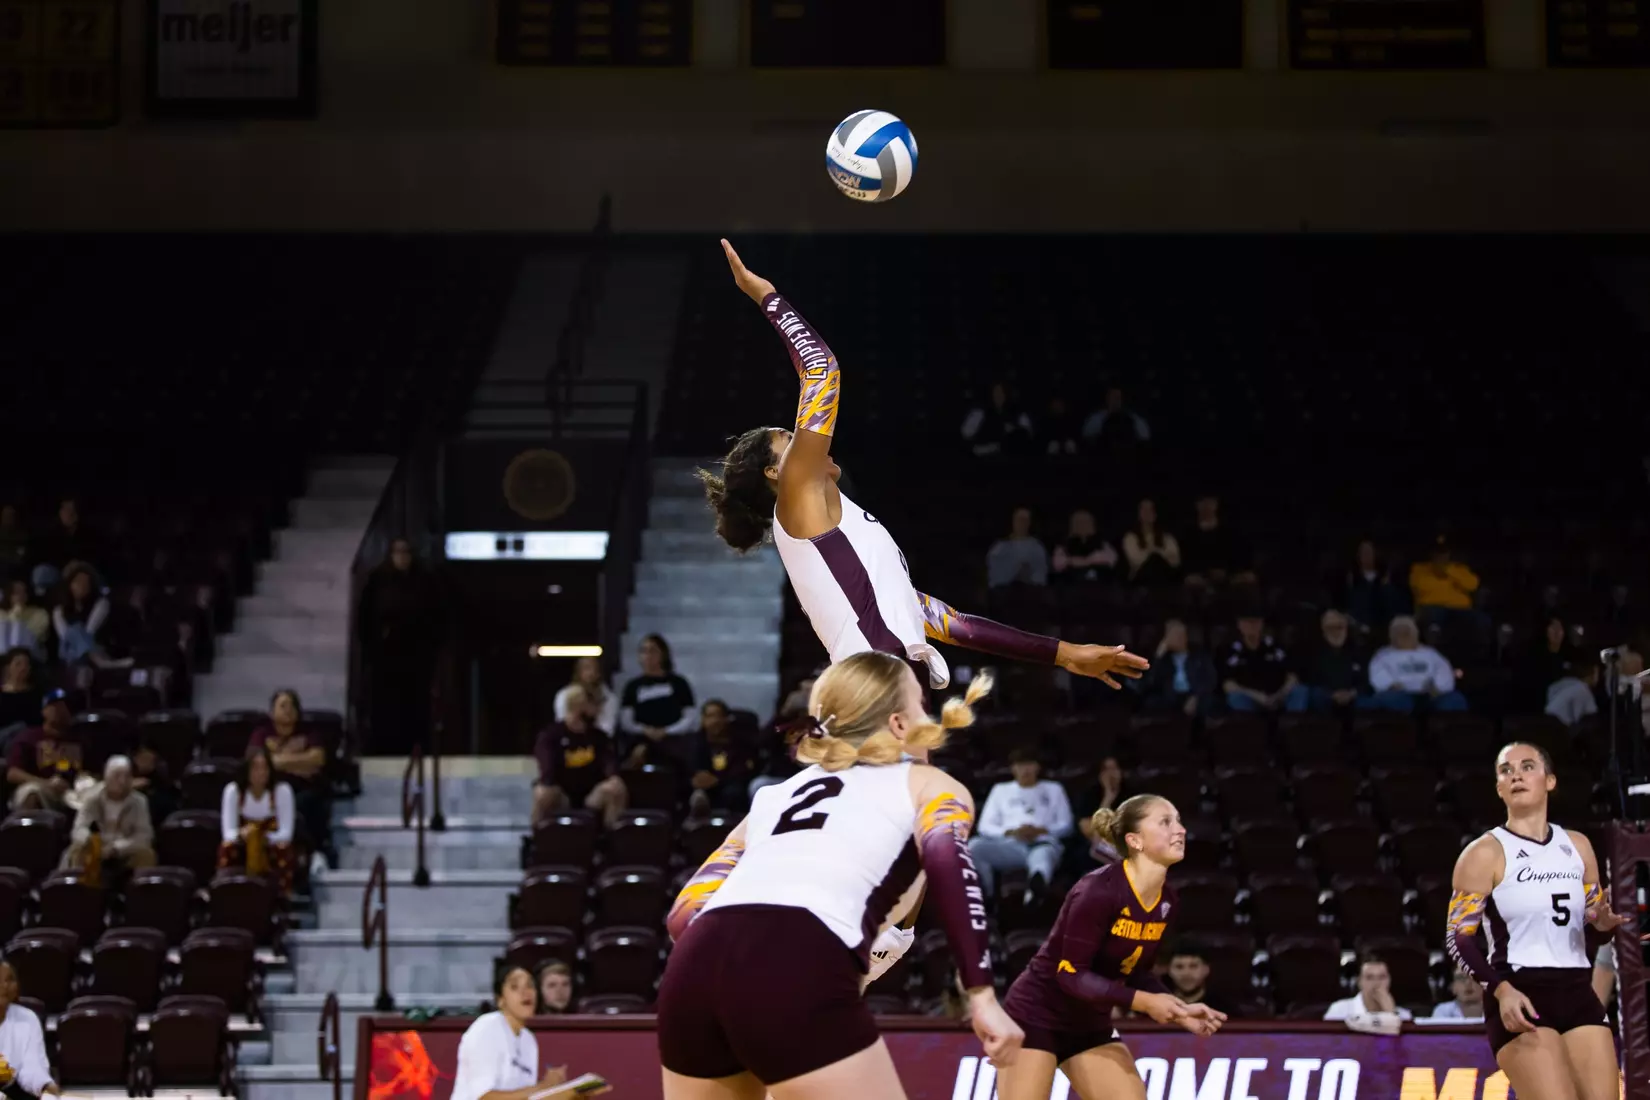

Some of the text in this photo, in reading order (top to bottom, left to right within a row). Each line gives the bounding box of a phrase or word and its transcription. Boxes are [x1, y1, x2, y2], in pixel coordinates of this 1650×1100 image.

[162, 1, 297, 53] meijer
[776, 311, 828, 380] CHIPPEWAS
[771, 776, 845, 836] 2
[1551, 893, 1571, 926] 5
[1120, 945, 1144, 976] 4
